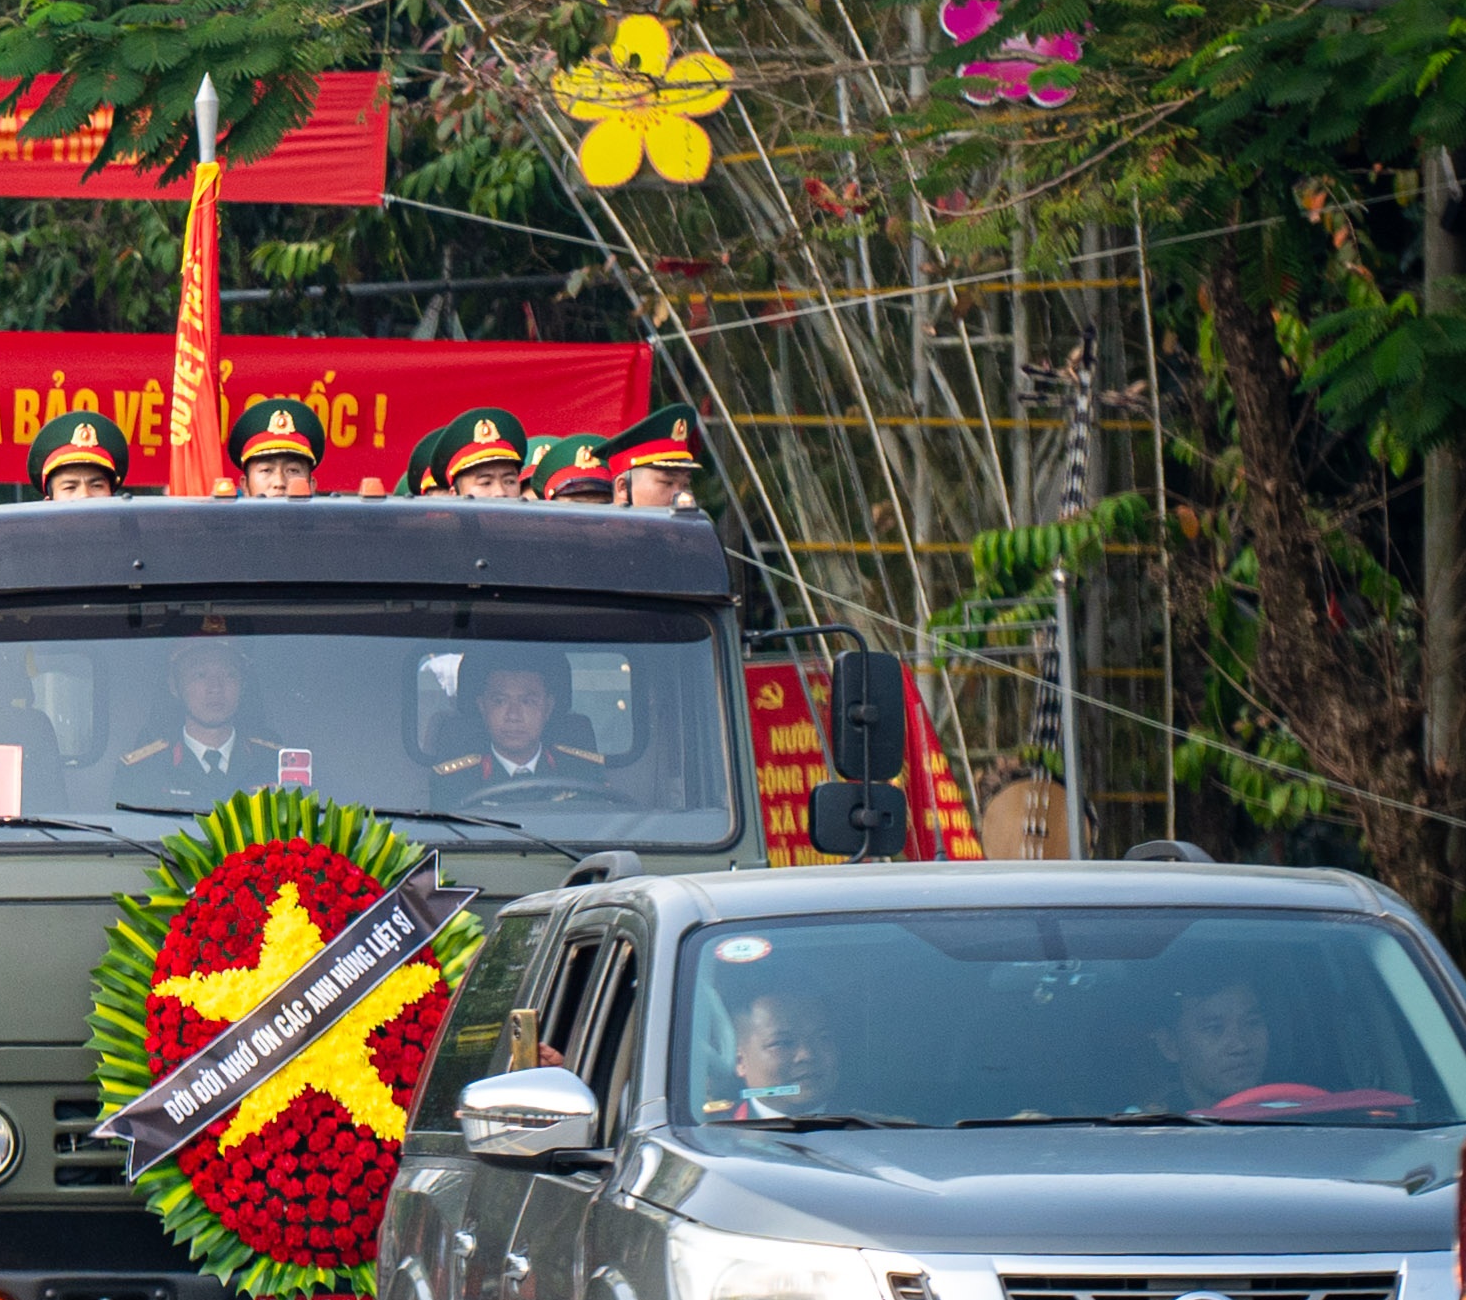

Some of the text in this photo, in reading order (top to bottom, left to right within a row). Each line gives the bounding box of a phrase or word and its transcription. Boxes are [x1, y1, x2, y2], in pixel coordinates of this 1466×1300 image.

[113, 379, 165, 456] VỆ
[372, 394, 388, 449] !
[163, 1088, 200, 1125] ĐỜI
[191, 1067, 228, 1104] ĐỜI
[217, 1040, 259, 1084] NHỚ
[250, 1027, 283, 1058] ƠN
[273, 999, 313, 1036] CÁC
[303, 978, 341, 1016] ANH
[370, 921, 402, 959] LIỆT
[391, 905, 416, 935] SĨ
